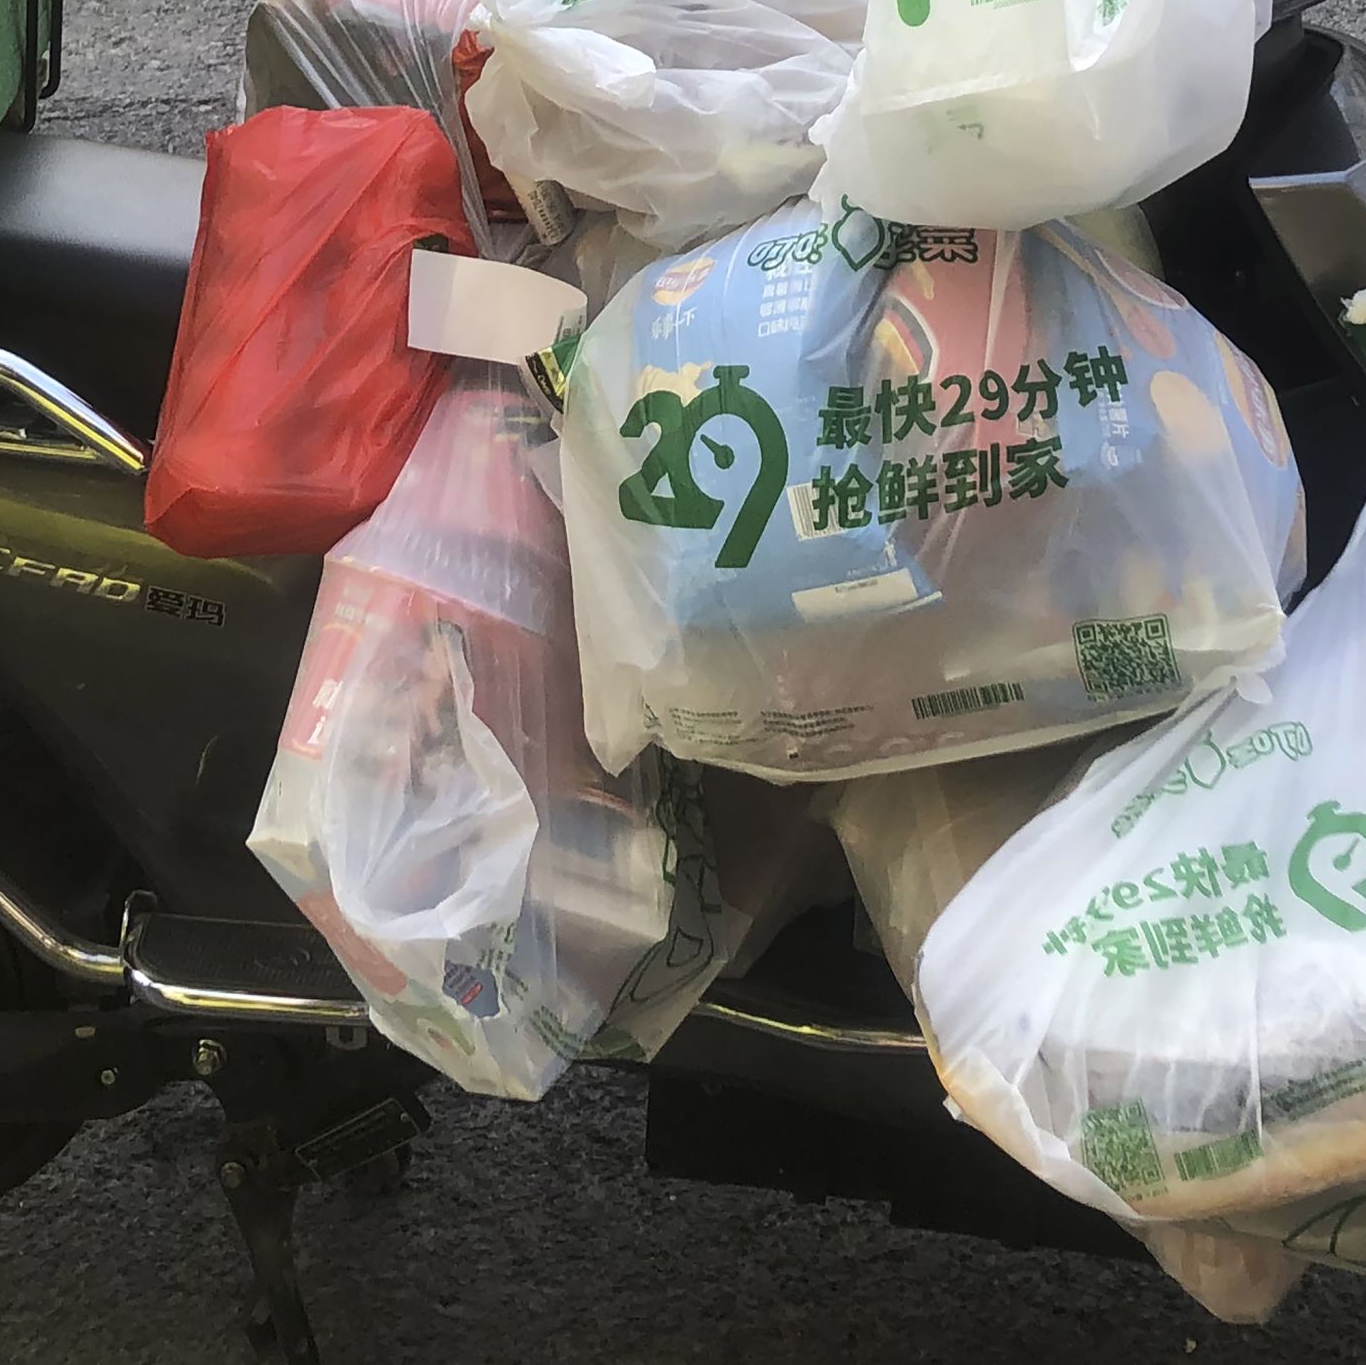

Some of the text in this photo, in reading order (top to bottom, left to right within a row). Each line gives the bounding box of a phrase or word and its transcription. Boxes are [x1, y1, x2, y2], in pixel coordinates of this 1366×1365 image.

[815, 344, 1129, 451] 最快29分钟
[811, 434, 1069, 532] 抢鲜到家
[145, 585, 227, 629] 爱玛
